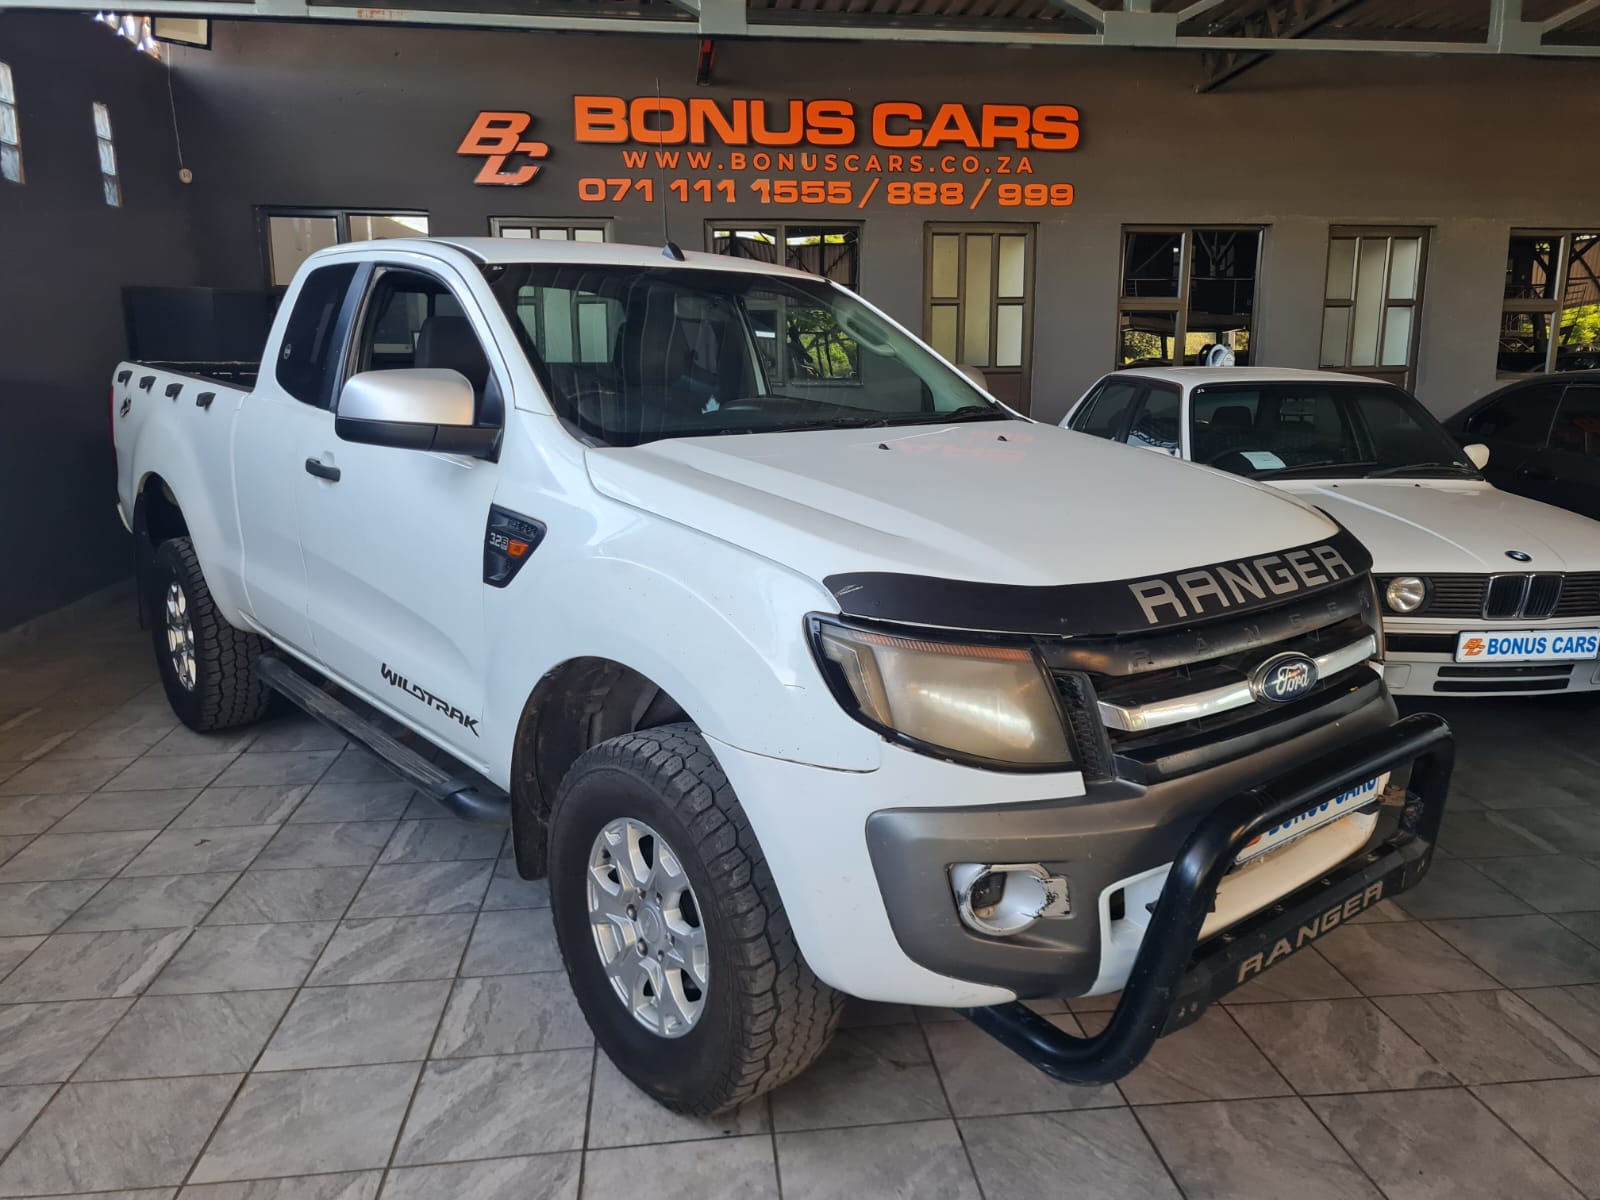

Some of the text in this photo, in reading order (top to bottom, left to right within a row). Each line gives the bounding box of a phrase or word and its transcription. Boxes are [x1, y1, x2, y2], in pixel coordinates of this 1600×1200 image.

[573, 96, 1080, 151] BONUS CARS
[622, 151, 1033, 174] WWW.BONUSCARS.CO.ZA
[577, 177, 655, 203] 071
[669, 177, 738, 204] 111
[1127, 544, 1356, 626] RANGER
[1487, 637, 1547, 655] BONUS
[1552, 636, 1597, 653] CARS
[380, 662, 480, 738] WILDTRAK
[1274, 664, 1310, 696] Ford
[1237, 880, 1384, 983] RANGER
